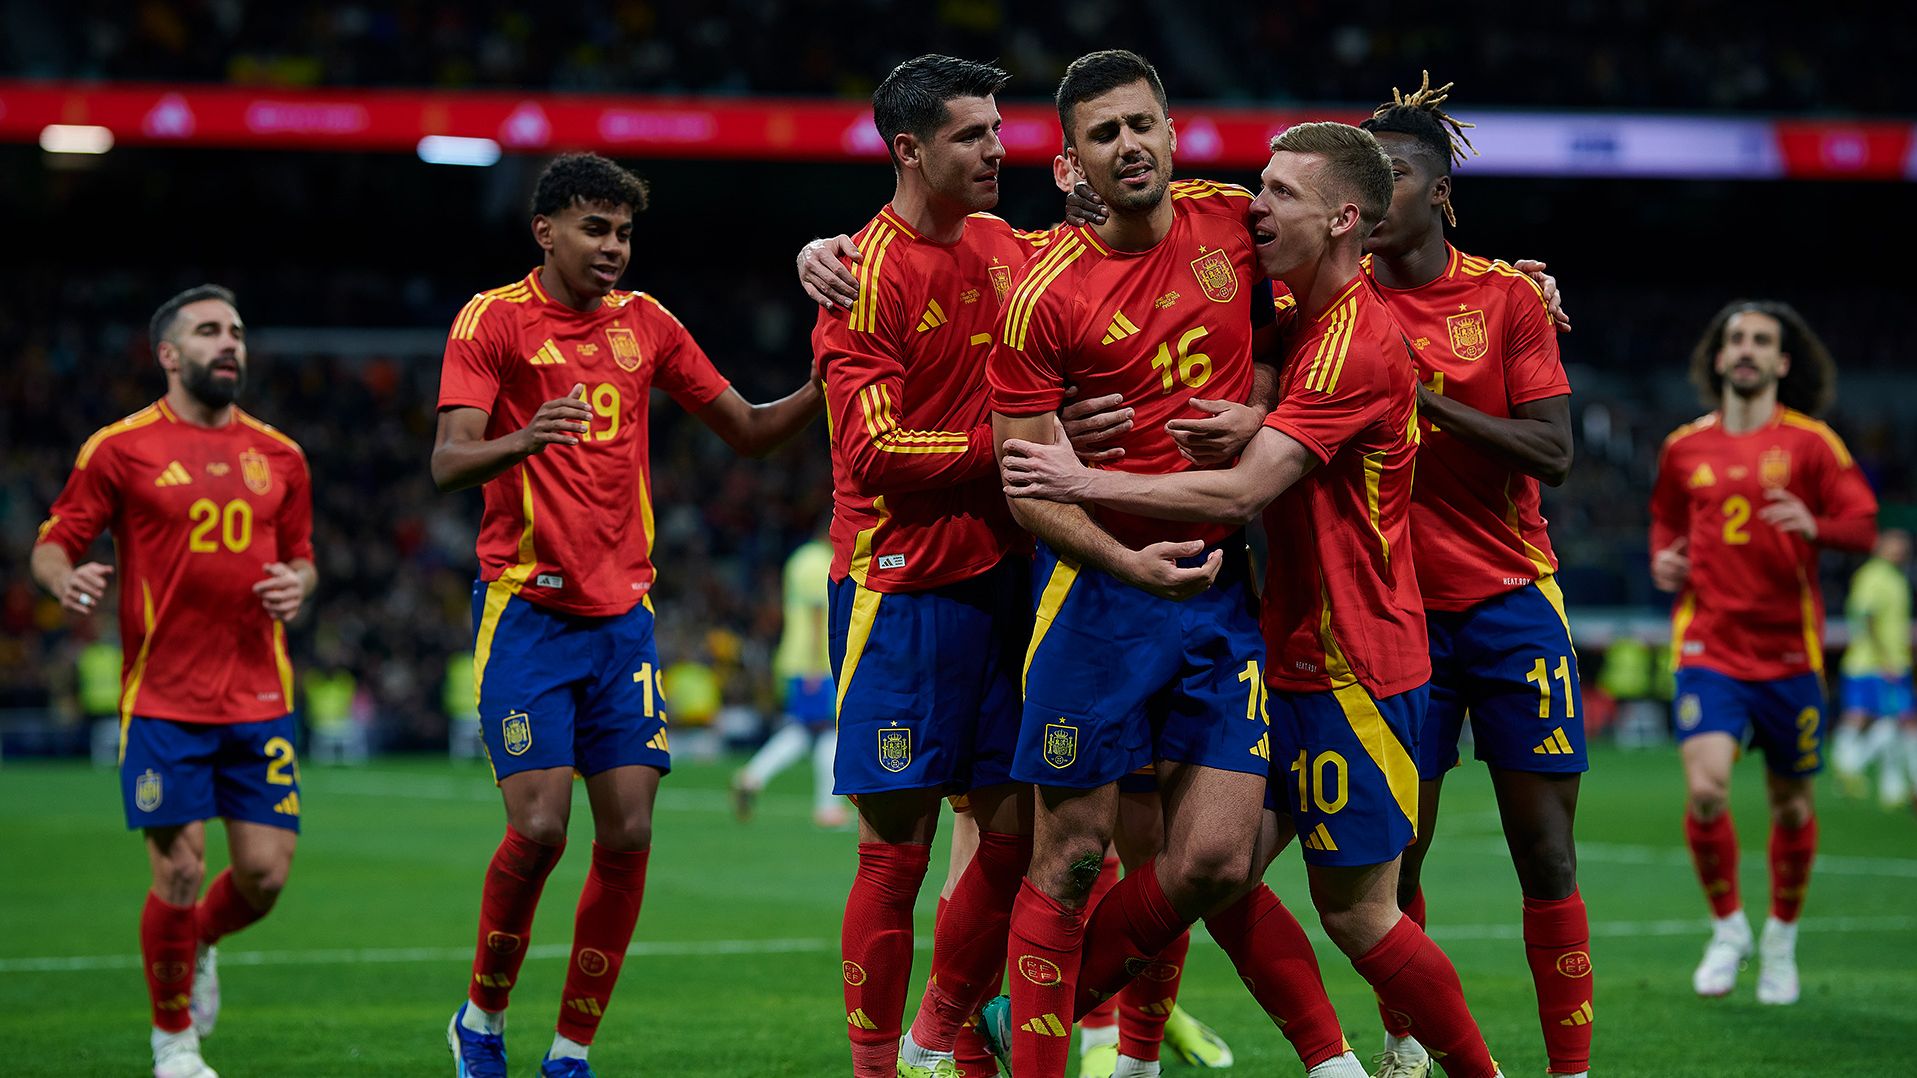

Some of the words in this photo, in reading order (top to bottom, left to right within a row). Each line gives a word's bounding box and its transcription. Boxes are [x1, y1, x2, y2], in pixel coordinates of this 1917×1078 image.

[1151, 326, 1212, 394] 16
[189, 498, 252, 553] 20
[1722, 496, 1751, 544] 2
[1526, 656, 1575, 718] 11
[1796, 706, 1820, 751] 2
[264, 736, 300, 785] 2
[1291, 749, 1348, 815] 10
